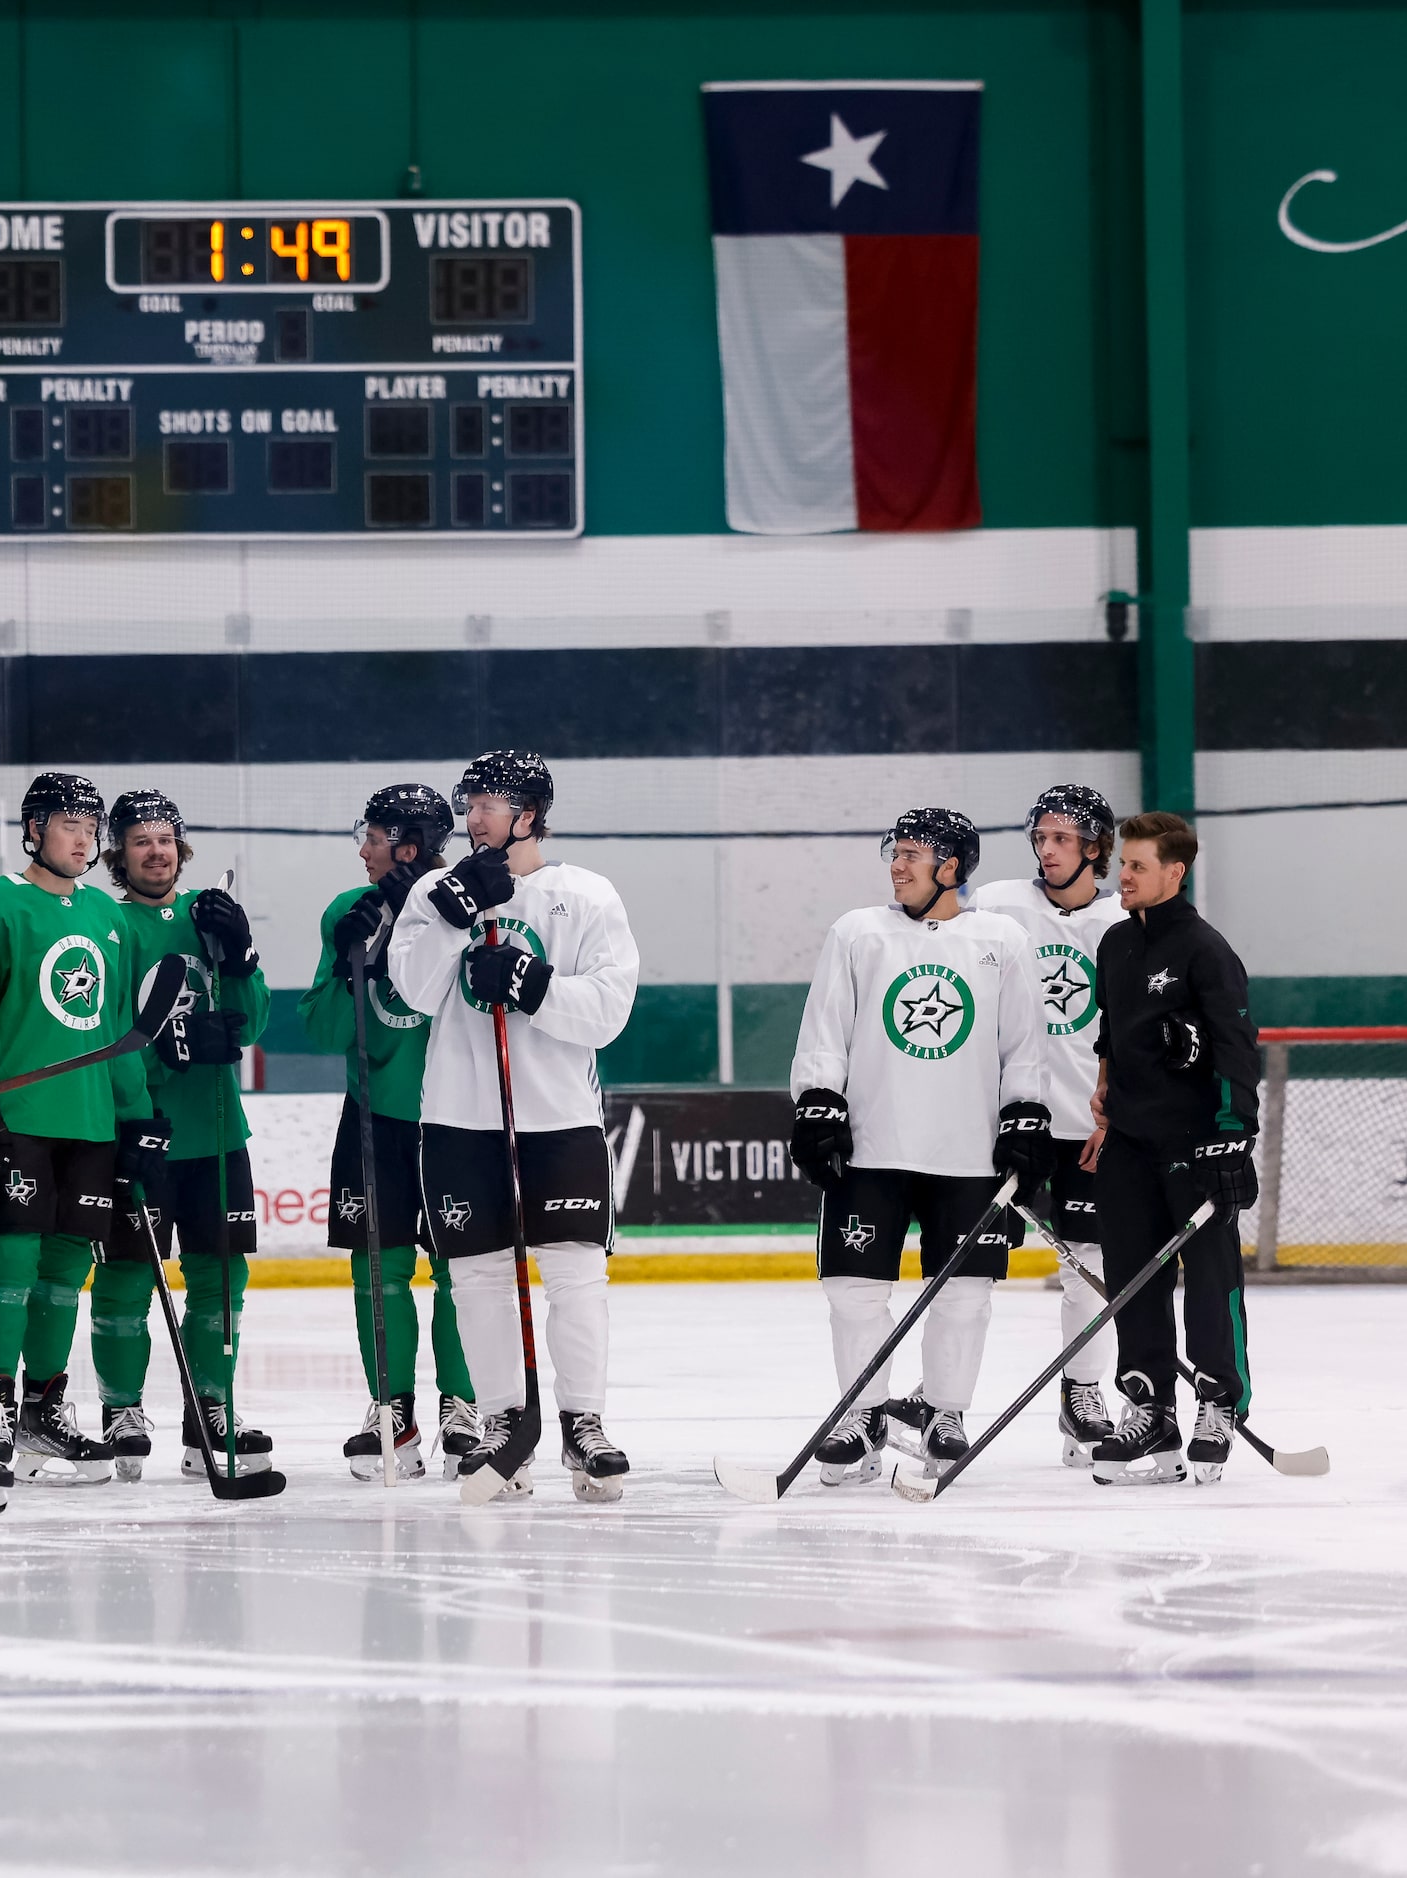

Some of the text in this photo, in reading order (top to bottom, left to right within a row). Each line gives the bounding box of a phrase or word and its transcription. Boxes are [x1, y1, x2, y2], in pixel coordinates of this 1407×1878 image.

[414, 213, 550, 249] VISITOR
[210, 219, 351, 283] 1:49
[138, 295, 184, 314] GOAL
[312, 295, 357, 313] GOAL
[184, 320, 266, 344] PERIOD
[432, 335, 503, 354] PENALTY
[41, 379, 133, 403] PENALTY
[365, 376, 446, 400] PLAYER
[478, 376, 571, 399] PENALTY
[159, 410, 338, 435] SHOTS ON GOAL
[478, 918, 530, 936] DLLAS
[58, 937, 98, 955] DALLAS
[1035, 942, 1084, 964] DALLAS
[906, 965, 959, 984] DALLAS
[387, 1012, 424, 1027] STARS
[1051, 1022, 1075, 1036] ARS
[903, 1042, 948, 1061] STARS
[796, 1106, 848, 1123] CCM
[998, 1117, 1052, 1135] CCM
[1195, 1140, 1247, 1159] CCM
[545, 1198, 602, 1212] CCM
